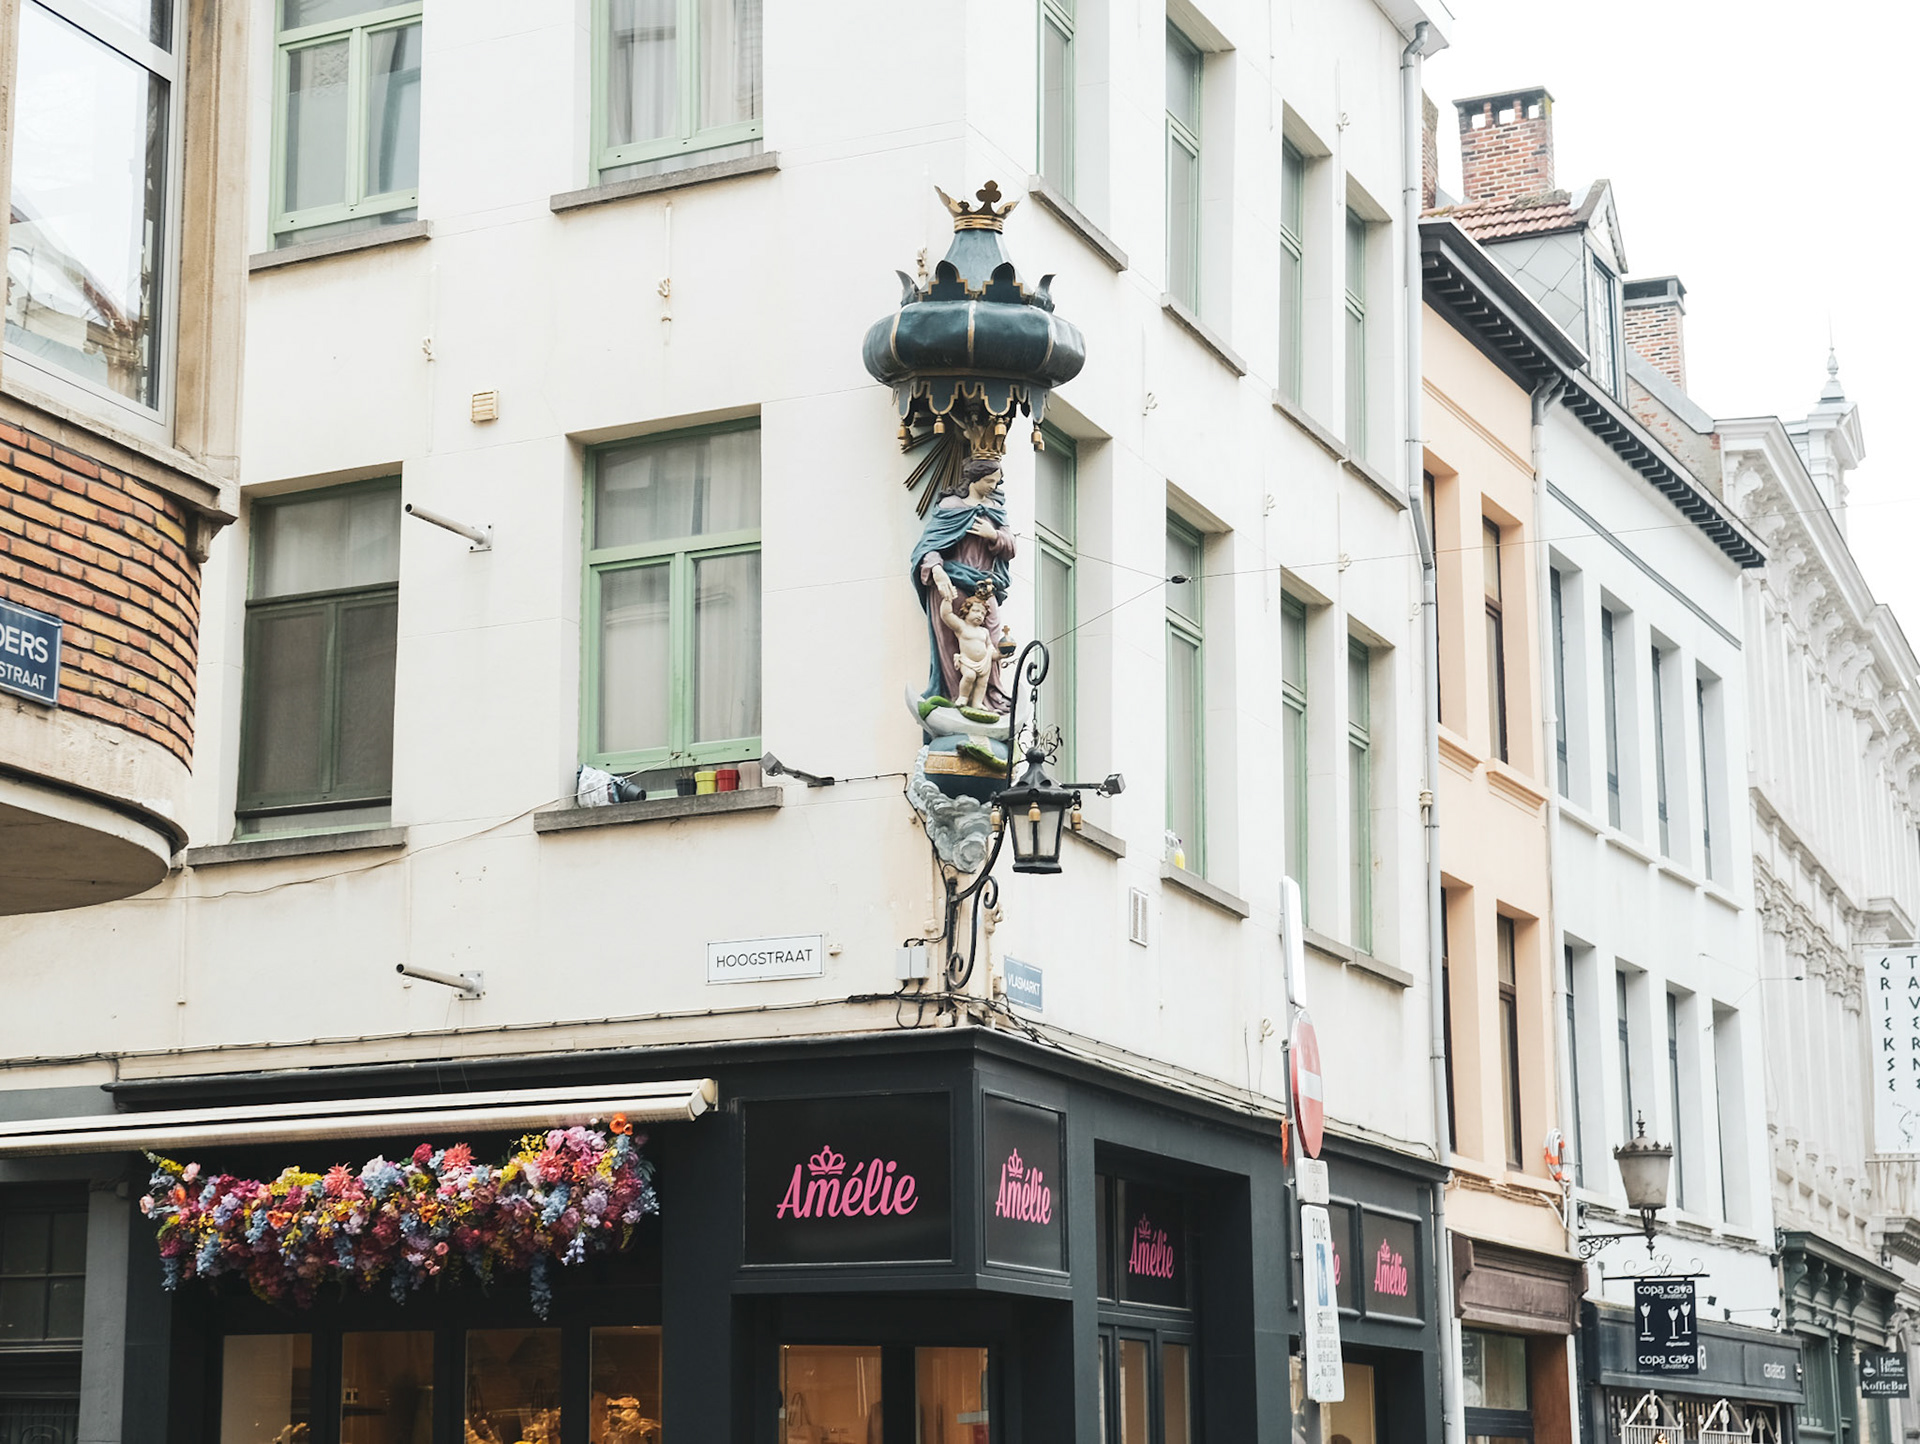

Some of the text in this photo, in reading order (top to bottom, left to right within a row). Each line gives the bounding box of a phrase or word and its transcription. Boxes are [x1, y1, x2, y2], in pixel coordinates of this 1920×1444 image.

[716, 948, 813, 968] HOOGSTRAAT
[1007, 972, 1041, 996] VLASMARKT
[1880, 957, 1895, 1092] GRIEKSE
[776, 1158, 918, 1219] Amélie
[995, 1163, 1052, 1224] Amélie
[1312, 1217, 1327, 1240] ZONE
[1128, 1226, 1175, 1279] Amélie
[1374, 1250, 1408, 1297] Amélie
[1637, 1283, 1693, 1296] copa cava
[1638, 1354, 1695, 1366] copa cava
